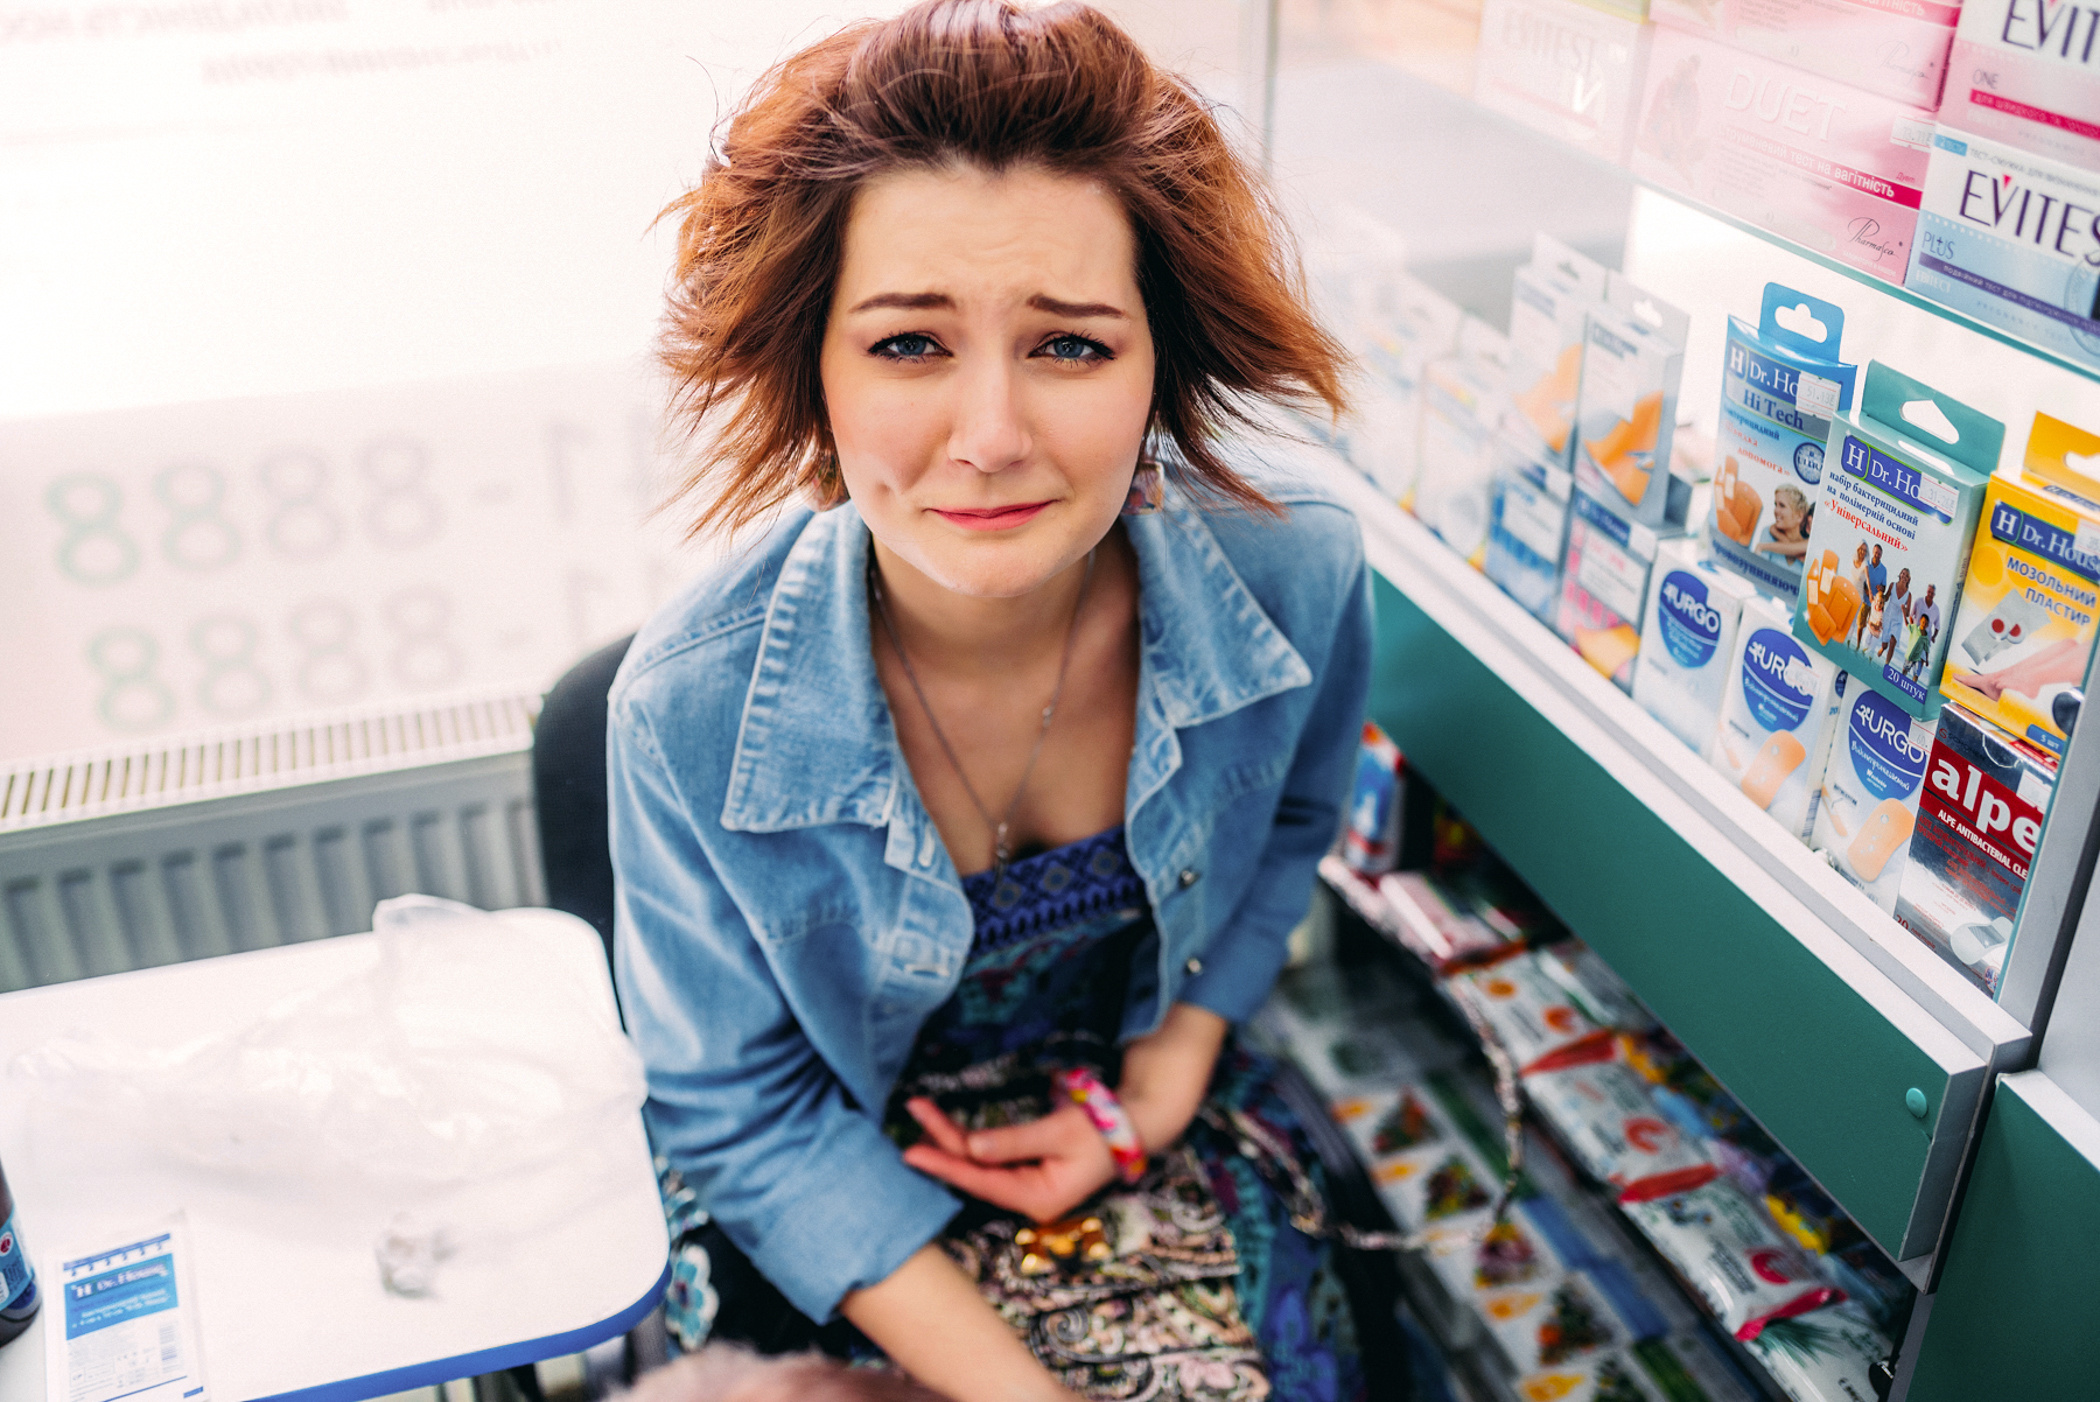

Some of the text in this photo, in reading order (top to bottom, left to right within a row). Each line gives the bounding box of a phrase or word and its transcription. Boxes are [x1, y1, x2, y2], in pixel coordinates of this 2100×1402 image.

[1724, 67, 1847, 143] DUET
[1790, 152, 1815, 167] тест
[1817, 158, 1831, 175] на
[1835, 167, 1895, 198] вагітність
[1750, 360, 1771, 386] Dr.
[1743, 389, 1804, 431] Hi Tech
[1846, 442, 1866, 471] H
[1871, 459, 1892, 486] Dr.
[1826, 484, 1916, 540] на полімерній основі
[1829, 471, 1919, 527] набір бактерицидний
[1824, 498, 1908, 552] «Універсальний»
[1996, 510, 2018, 536] H
[2022, 524, 2046, 549] Dr.
[2007, 556, 2097, 608] МОЗОЛЬНИЙ
[2025, 587, 2091, 626] ПЛАСТИР
[1672, 584, 1720, 633] URGO
[1887, 668, 1925, 701] 20 штук
[1869, 708, 1925, 764] URGO
[1931, 758, 2041, 855] alpe
[1938, 809, 1956, 828] ALPE
[1956, 822, 2012, 870] ANTIBACTERIAL
